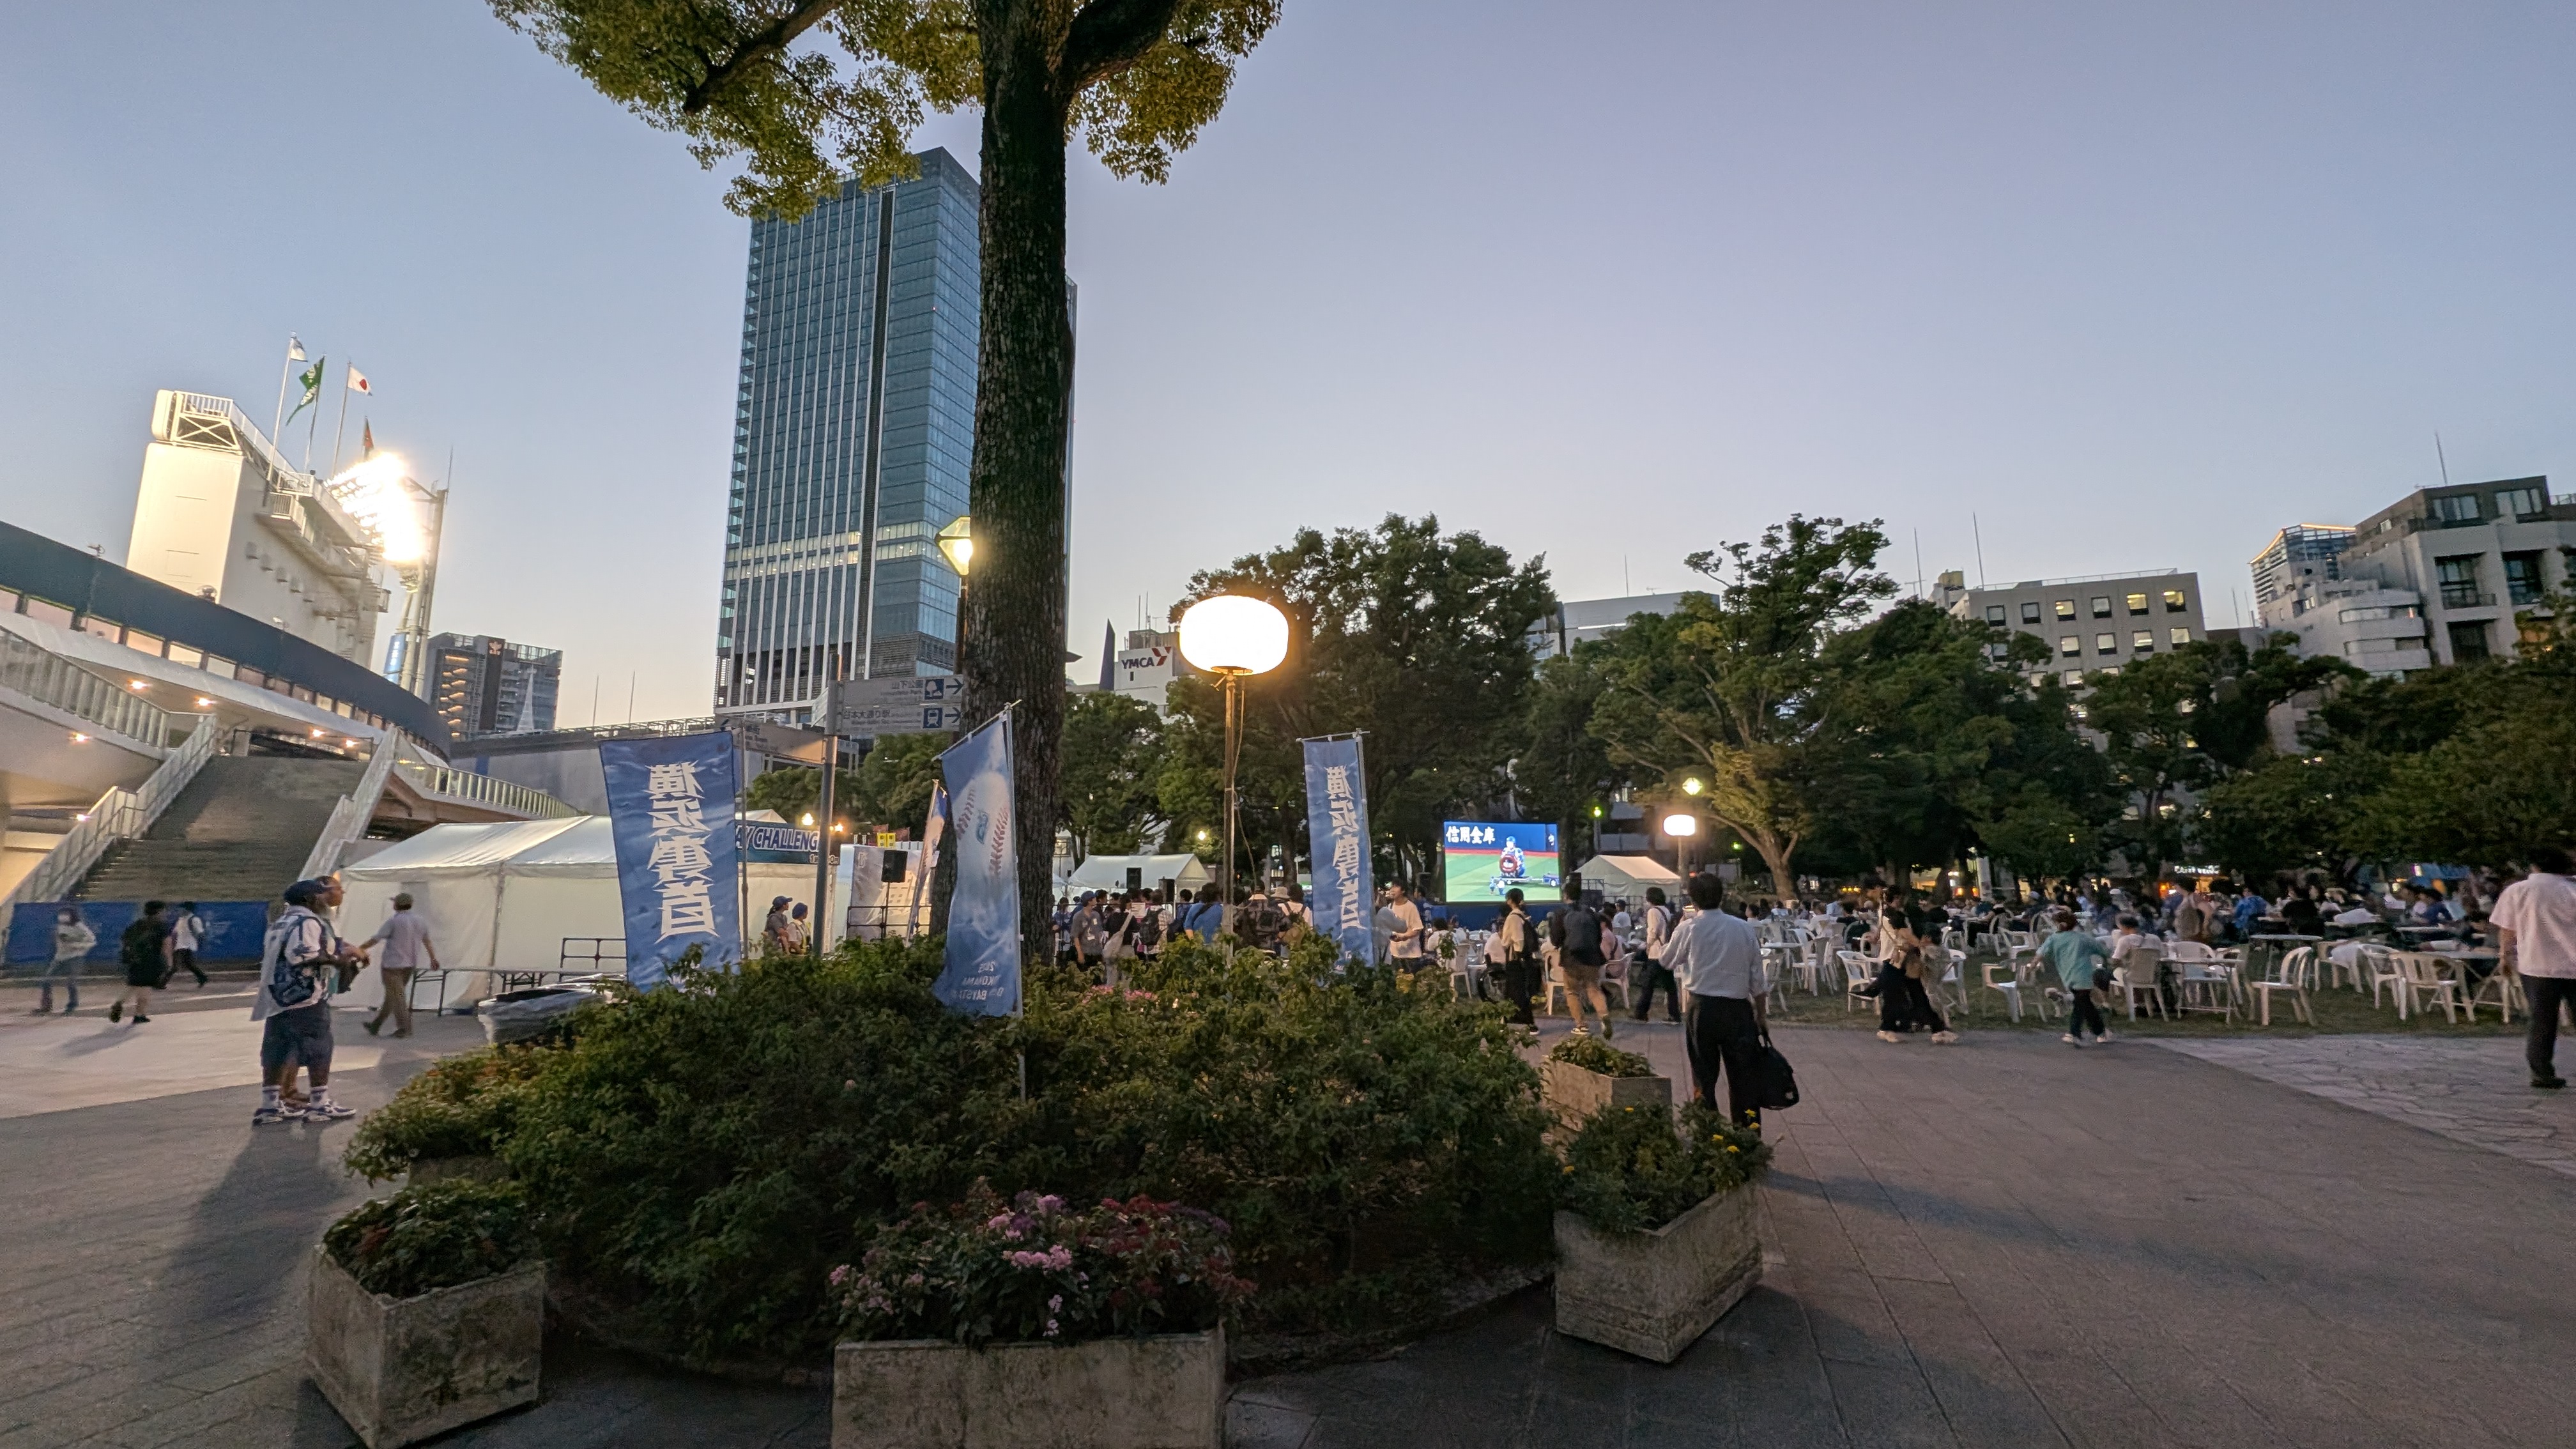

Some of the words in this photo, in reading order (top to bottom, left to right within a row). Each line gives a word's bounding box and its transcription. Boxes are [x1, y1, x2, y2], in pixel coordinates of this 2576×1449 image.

[1121, 657, 1154, 670] YMCA
[1446, 825, 1496, 845] 信用金庫
